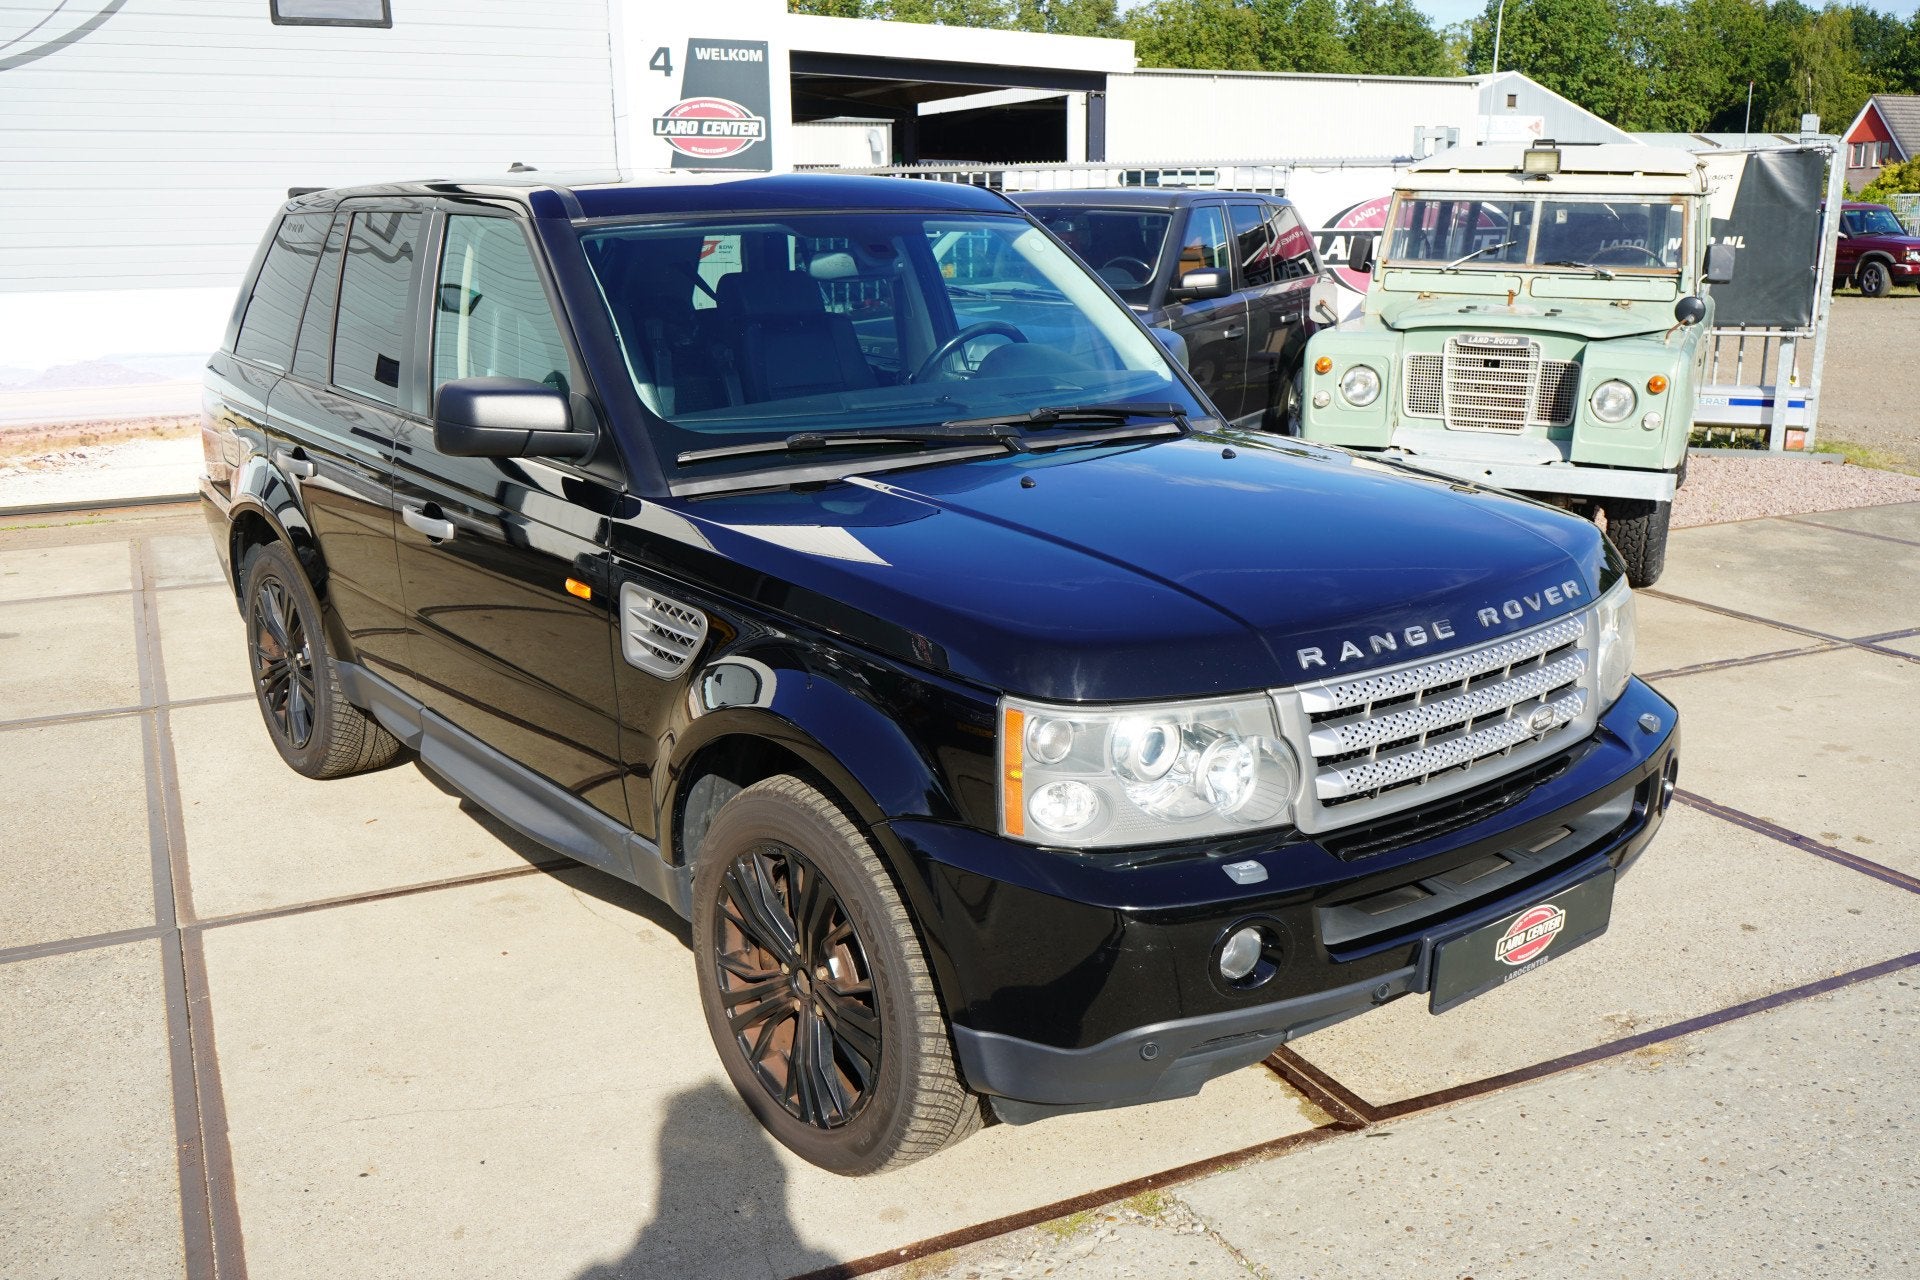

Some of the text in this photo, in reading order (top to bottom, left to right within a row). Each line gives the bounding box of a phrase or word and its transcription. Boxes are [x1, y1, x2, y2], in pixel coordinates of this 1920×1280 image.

[649, 47, 673, 76] 4
[695, 47, 763, 62] WELKOM
[656, 120, 760, 136] LARO CENTER
[1348, 206, 1381, 227] LAND-
[1296, 579, 1582, 671] RANGE ROVER
[1498, 932, 1526, 955] LARO
[1526, 916, 1562, 941] CENTER
[1503, 955, 1549, 982] LAROCENTER
